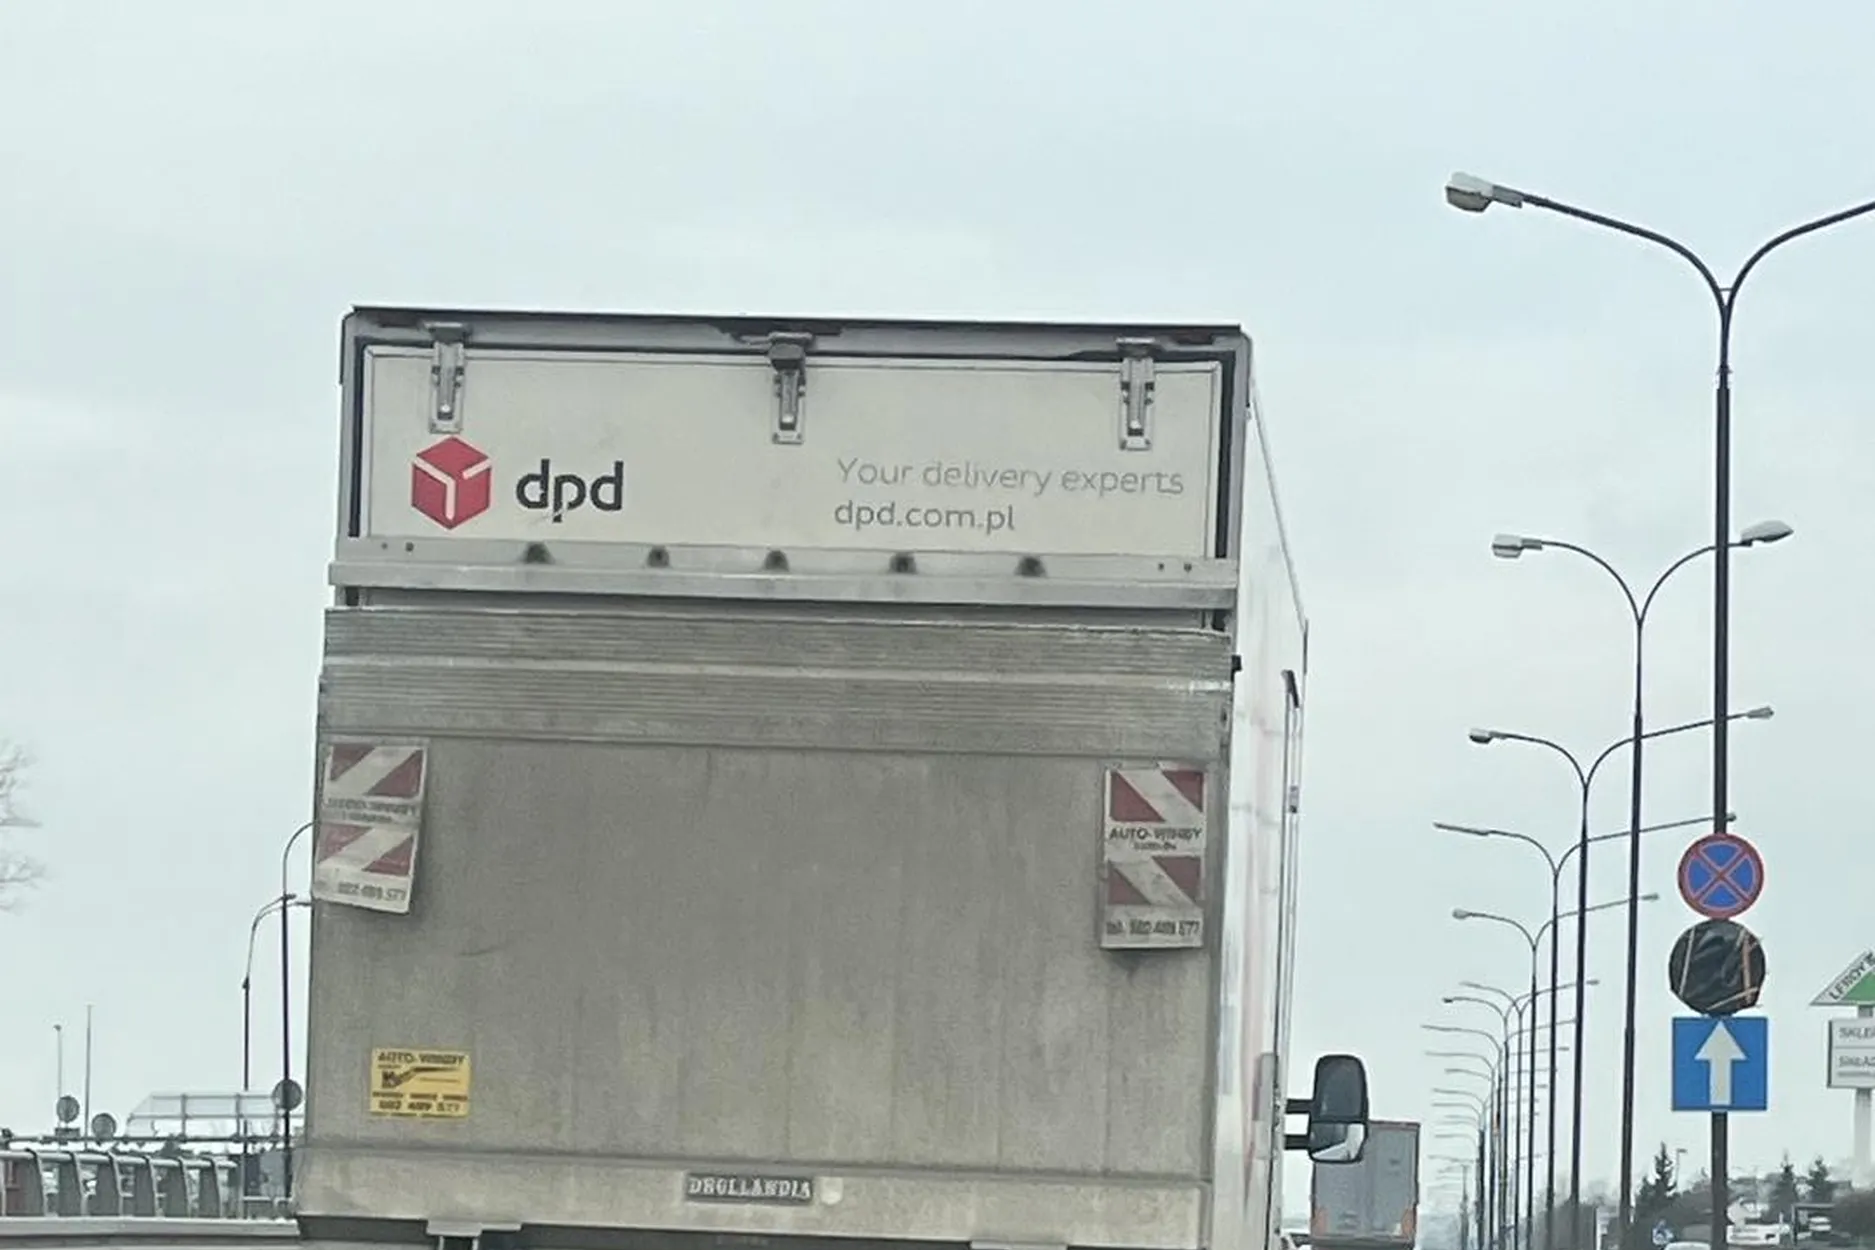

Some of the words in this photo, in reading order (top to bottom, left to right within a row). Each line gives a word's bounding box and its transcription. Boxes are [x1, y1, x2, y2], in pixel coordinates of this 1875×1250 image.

[516, 458, 623, 523] dpd
[838, 458, 913, 487] Your
[922, 460, 1052, 497] delivery
[1060, 468, 1185, 497] experts
[834, 500, 1015, 535] dpd.com.pl
